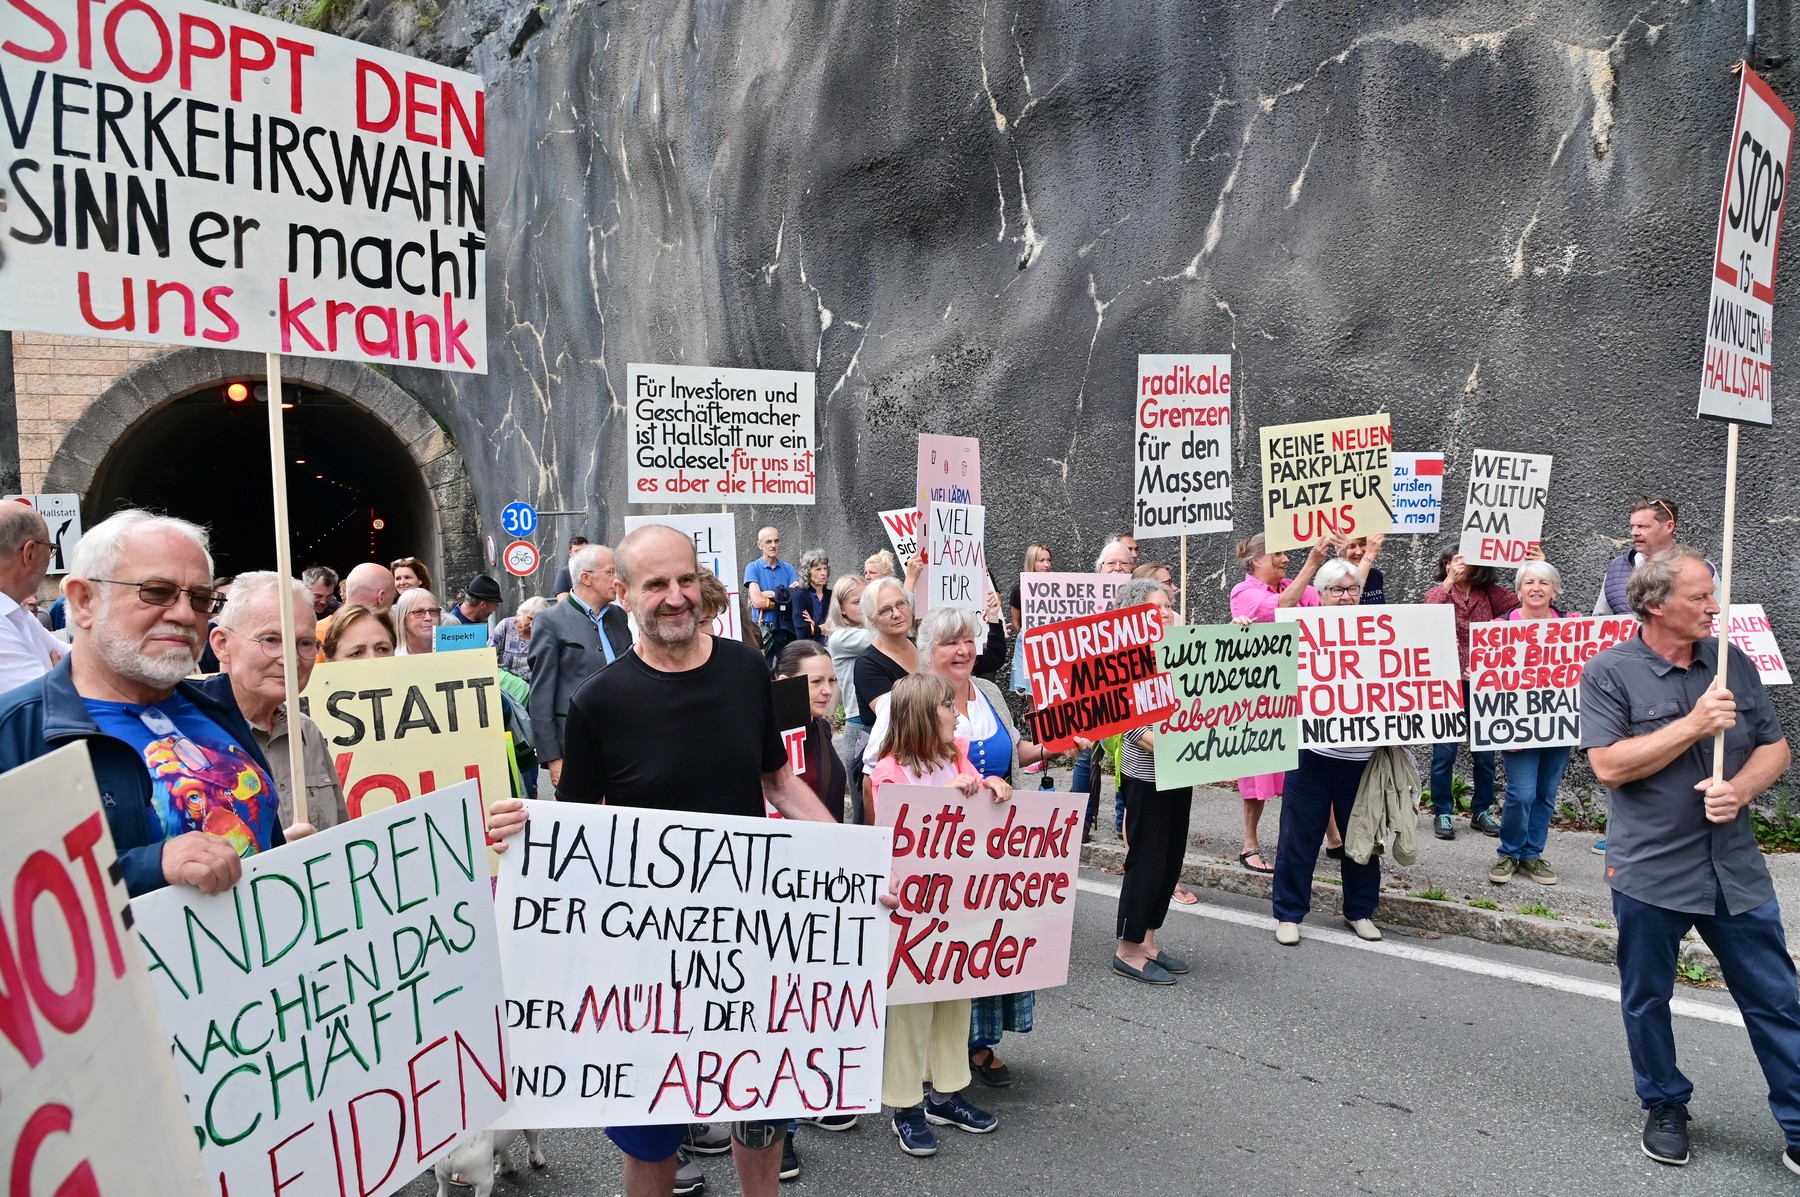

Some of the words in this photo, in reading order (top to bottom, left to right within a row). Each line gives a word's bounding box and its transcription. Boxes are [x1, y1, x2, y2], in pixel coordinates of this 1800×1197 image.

[2, 0, 314, 114] STOPPT
[356, 58, 486, 158] DEN
[0, 64, 486, 233] VERKEHRSWAHN
[1728, 130, 1784, 247] STOP
[8, 158, 170, 259] SINN
[189, 211, 260, 269] er
[288, 223, 486, 300] macht
[78, 271, 239, 342] uns
[279, 277, 476, 370] krank
[1710, 295, 1764, 355] MINUTEN
[636, 375, 666, 398] Für
[671, 376, 757, 401] Investoren
[765, 382, 798, 404] und
[1141, 364, 1231, 396] radikale
[1704, 344, 1773, 402] HALLSTATT
[635, 398, 801, 427] Geschäftemacher
[1139, 397, 1231, 429] Grenzen
[636, 423, 658, 445] ist
[662, 423, 744, 447] Hallstatt
[746, 434, 775, 448] nur
[780, 429, 807, 449] ein
[1138, 431, 1171, 462] für
[1181, 430, 1220, 460] den
[1268, 433, 1325, 461] KEINE
[1331, 424, 1393, 452] NEUEN
[731, 447, 758, 474] für
[762, 457, 789, 472] uns
[793, 449, 814, 472] ist
[1270, 447, 1388, 484] PARKPLÄTZE
[1394, 467, 1409, 476] zu
[1474, 454, 1538, 482] WELT-
[636, 476, 659, 492] es
[665, 469, 710, 493] aber
[716, 469, 747, 494] die
[752, 470, 816, 495] Heimat
[1137, 464, 1230, 494] Massen
[1268, 480, 1333, 519] PLATZ
[1340, 472, 1394, 520] FÜR
[1393, 478, 1432, 492] uristen
[1468, 482, 1548, 510] KULTUR
[40, 509, 77, 517] Hallstatt
[375, 520, 383, 528] 50
[506, 508, 533, 531] 30
[936, 506, 974, 536] VIEL
[1136, 496, 1234, 527] tourismus
[1293, 504, 1356, 542] UNS
[1463, 510, 1511, 535] AM
[933, 534, 984, 569] LÄRM
[942, 573, 973, 602] FÜR
[1027, 582, 1061, 598] VOR
[1066, 583, 1097, 599] DER
[441, 632, 475, 642] Respekt!
[1025, 608, 1162, 670] TOURISMUS
[1161, 627, 1207, 670] wir
[1215, 624, 1292, 663] müssen
[1296, 614, 1396, 651] ALLES
[1472, 622, 1540, 649] KEINE
[1544, 620, 1595, 645] ZEIT
[1379, 647, 1431, 679] DIE
[1470, 645, 1517, 673] FÜR
[1133, 673, 1177, 716] NEIN
[1179, 662, 1282, 699] unseren
[1475, 663, 1584, 693] AUSRED
[1159, 694, 1300, 735] Lebensraum
[1473, 690, 1520, 718] WIR
[1175, 722, 1287, 763] schützen
[1302, 716, 1380, 744] NICHTS
[1384, 713, 1426, 742] FÜR
[1431, 710, 1468, 740] UNS
[1474, 714, 1580, 747] LÖSUN
[892, 803, 978, 859] bitte
[986, 804, 1080, 861] denkt
[521, 813, 792, 895] HALLSTATT
[772, 866, 885, 906] GEHÖRT
[899, 876, 951, 914] an
[963, 868, 1070, 911] unsere
[513, 896, 587, 934] DER
[392, 901, 476, 981] DAS
[886, 909, 1037, 988] Kinder
[671, 949, 745, 994] UNS
[505, 999, 566, 1031] DER
[703, 1001, 757, 1032] DER
[766, 972, 880, 1035] LÄRM
[512, 1064, 566, 1098] ND
[581, 1063, 635, 1098] DIE
[648, 1046, 867, 1119] ABGASE
